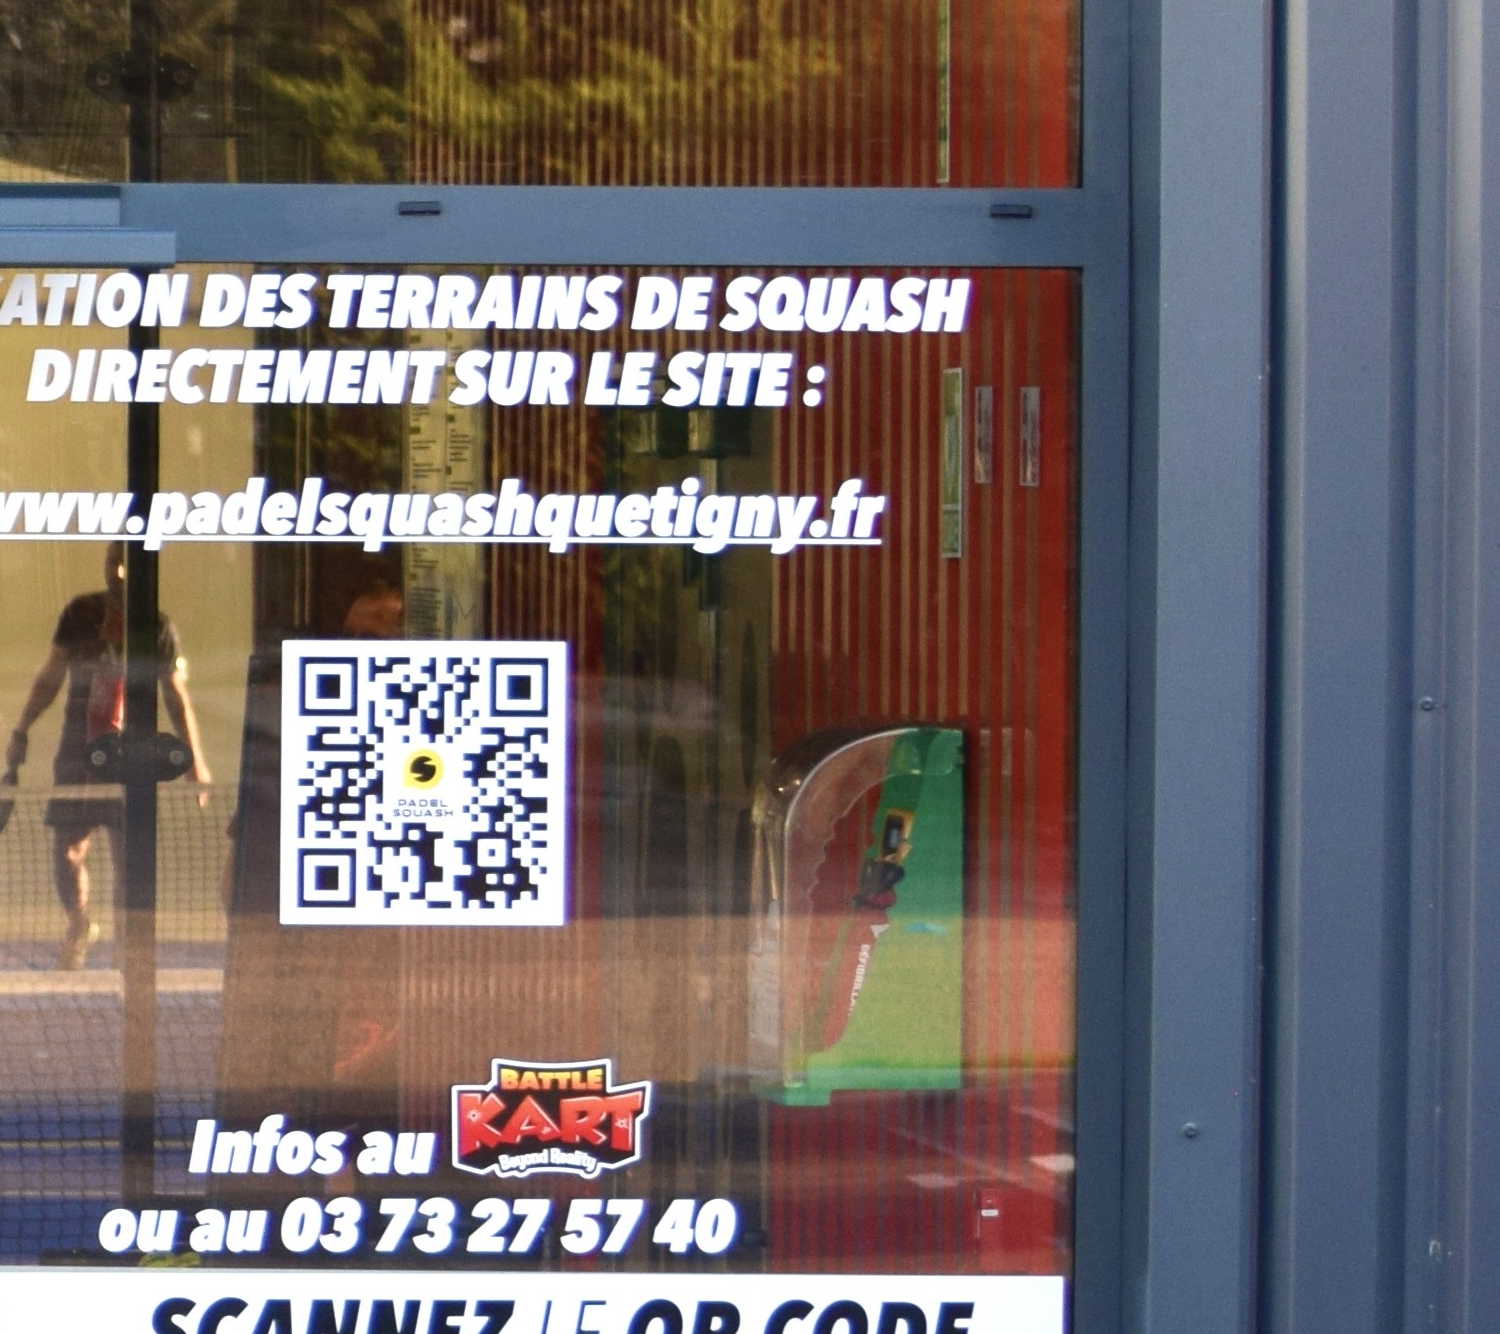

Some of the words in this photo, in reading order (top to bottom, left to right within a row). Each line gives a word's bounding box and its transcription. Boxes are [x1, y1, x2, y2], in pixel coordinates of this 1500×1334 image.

[199, 273, 317, 329] DES
[326, 274, 623, 331] TERRAINS
[630, 276, 713, 331] DE
[717, 276, 971, 333] SQUASH
[26, 348, 447, 404] DIRECTEMENT
[447, 349, 574, 406] SUR
[584, 351, 656, 406] LE
[660, 351, 793, 407] SITE
[392, 808, 455, 818] SQUASH
[397, 798, 449, 808] PADEL
[500, 1067, 604, 1091] BATTLE
[188, 1114, 347, 1175] Infos
[356, 1130, 435, 1175] au
[459, 1090, 644, 1157] KART
[498, 1149, 550, 1171] Beyond
[550, 1146, 598, 1172] Reality
[98, 1208, 178, 1253] ou
[189, 1208, 267, 1253] au
[281, 1196, 362, 1253] 03
[375, 1197, 456, 1253] 73
[466, 1197, 550, 1252] 27
[560, 1198, 644, 1254] 57
[652, 1198, 736, 1254] 40
